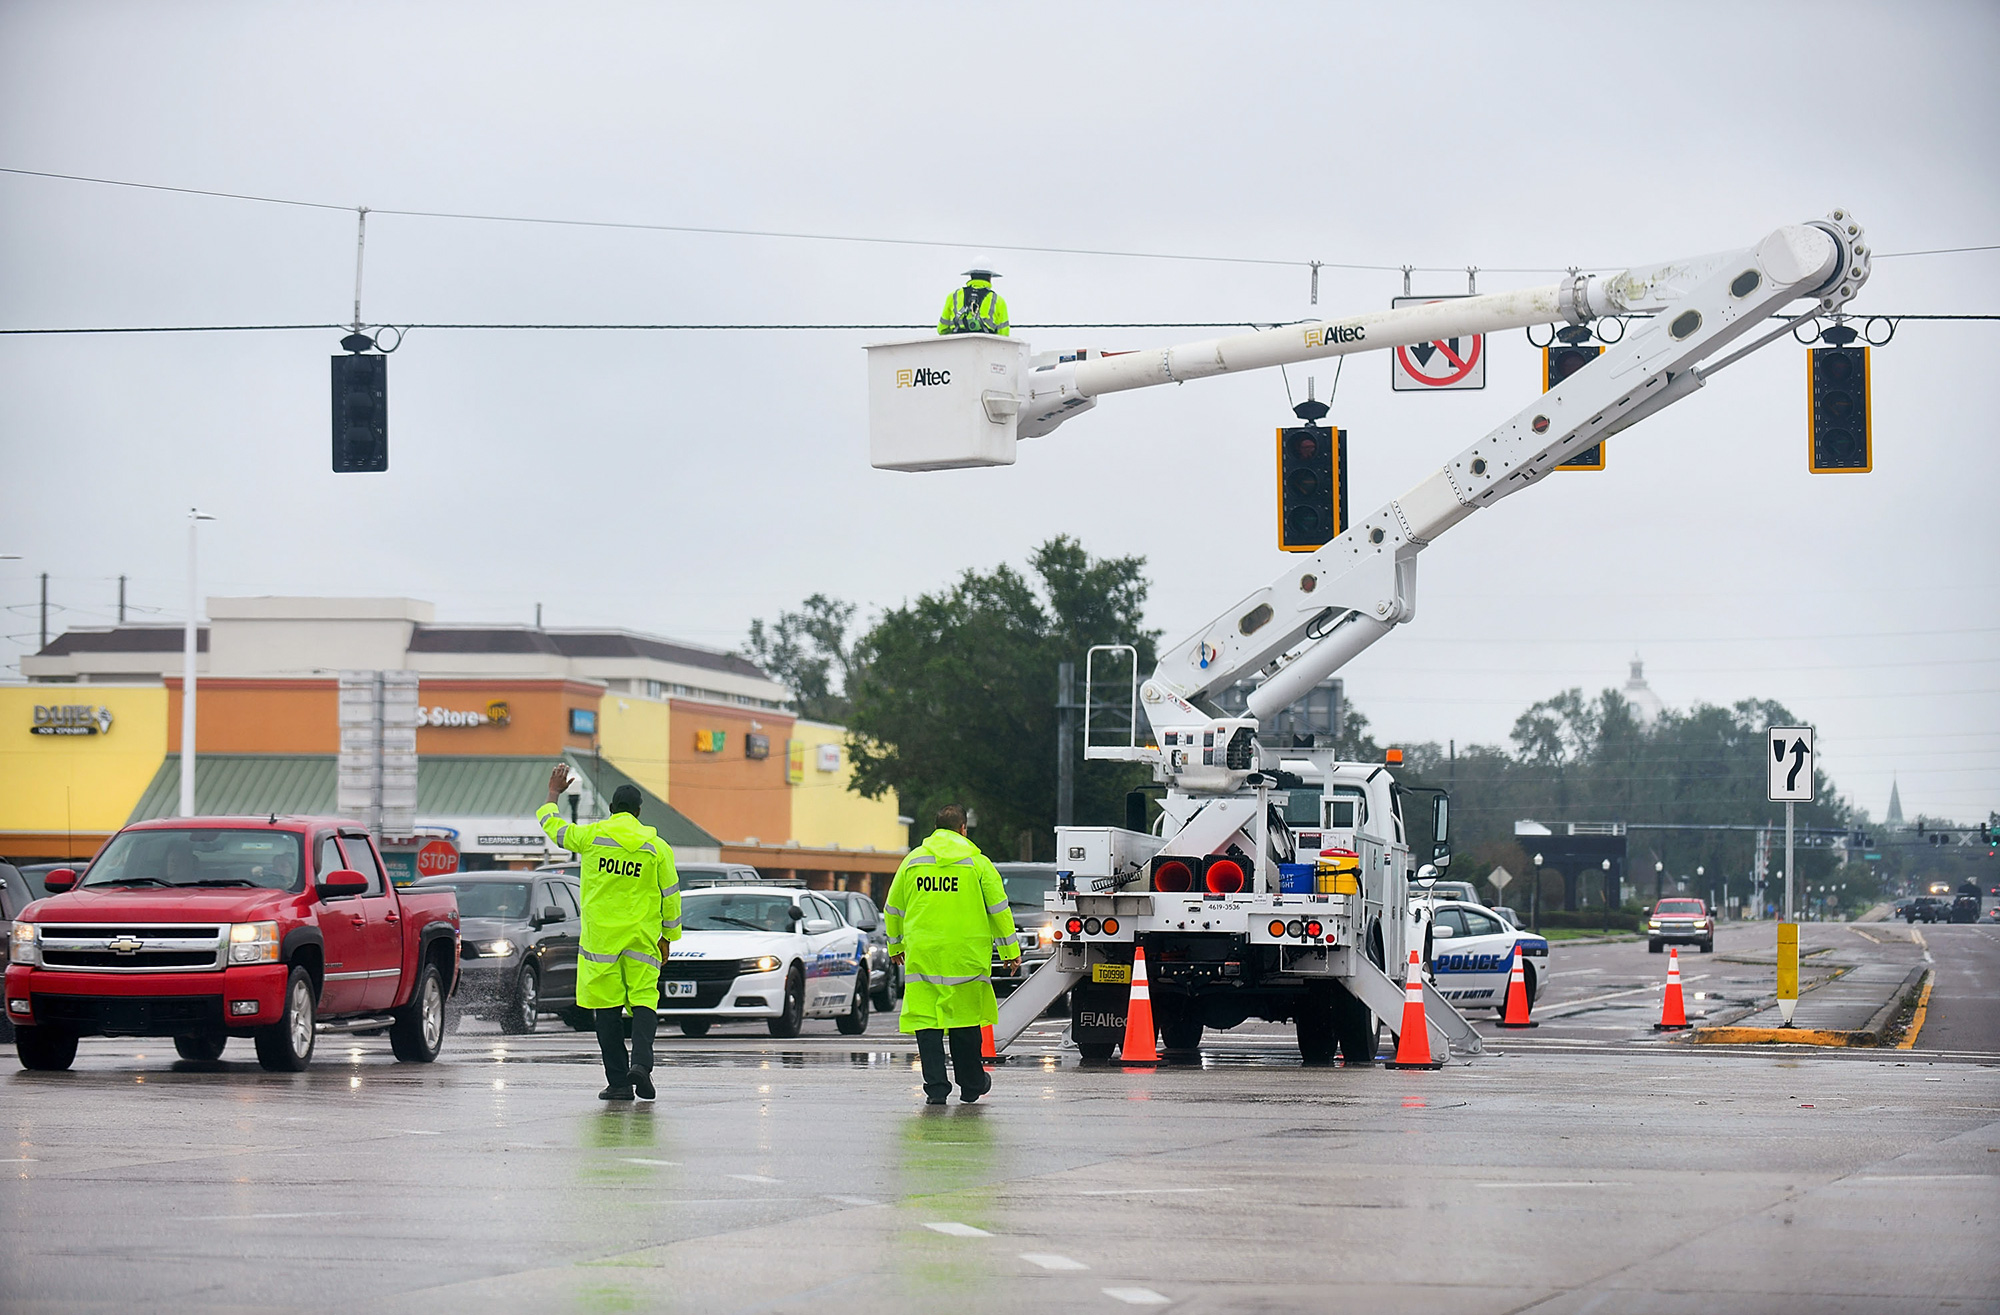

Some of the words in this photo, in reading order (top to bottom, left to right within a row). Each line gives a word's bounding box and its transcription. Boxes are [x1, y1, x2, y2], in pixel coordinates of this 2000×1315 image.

[1324, 325, 1366, 346] Altec
[913, 367, 951, 387] Altec
[432, 705, 480, 727] Store
[479, 836, 521, 845] CLEARANCE
[420, 852, 457, 871] STOP
[598, 857, 643, 878] POLICE
[916, 876, 959, 892] POLICE
[1208, 903, 1241, 911] 4619-3536
[1436, 954, 1501, 971] POLICE
[1452, 990, 1462, 1000] OF
[1462, 989, 1496, 999] BARTOW
